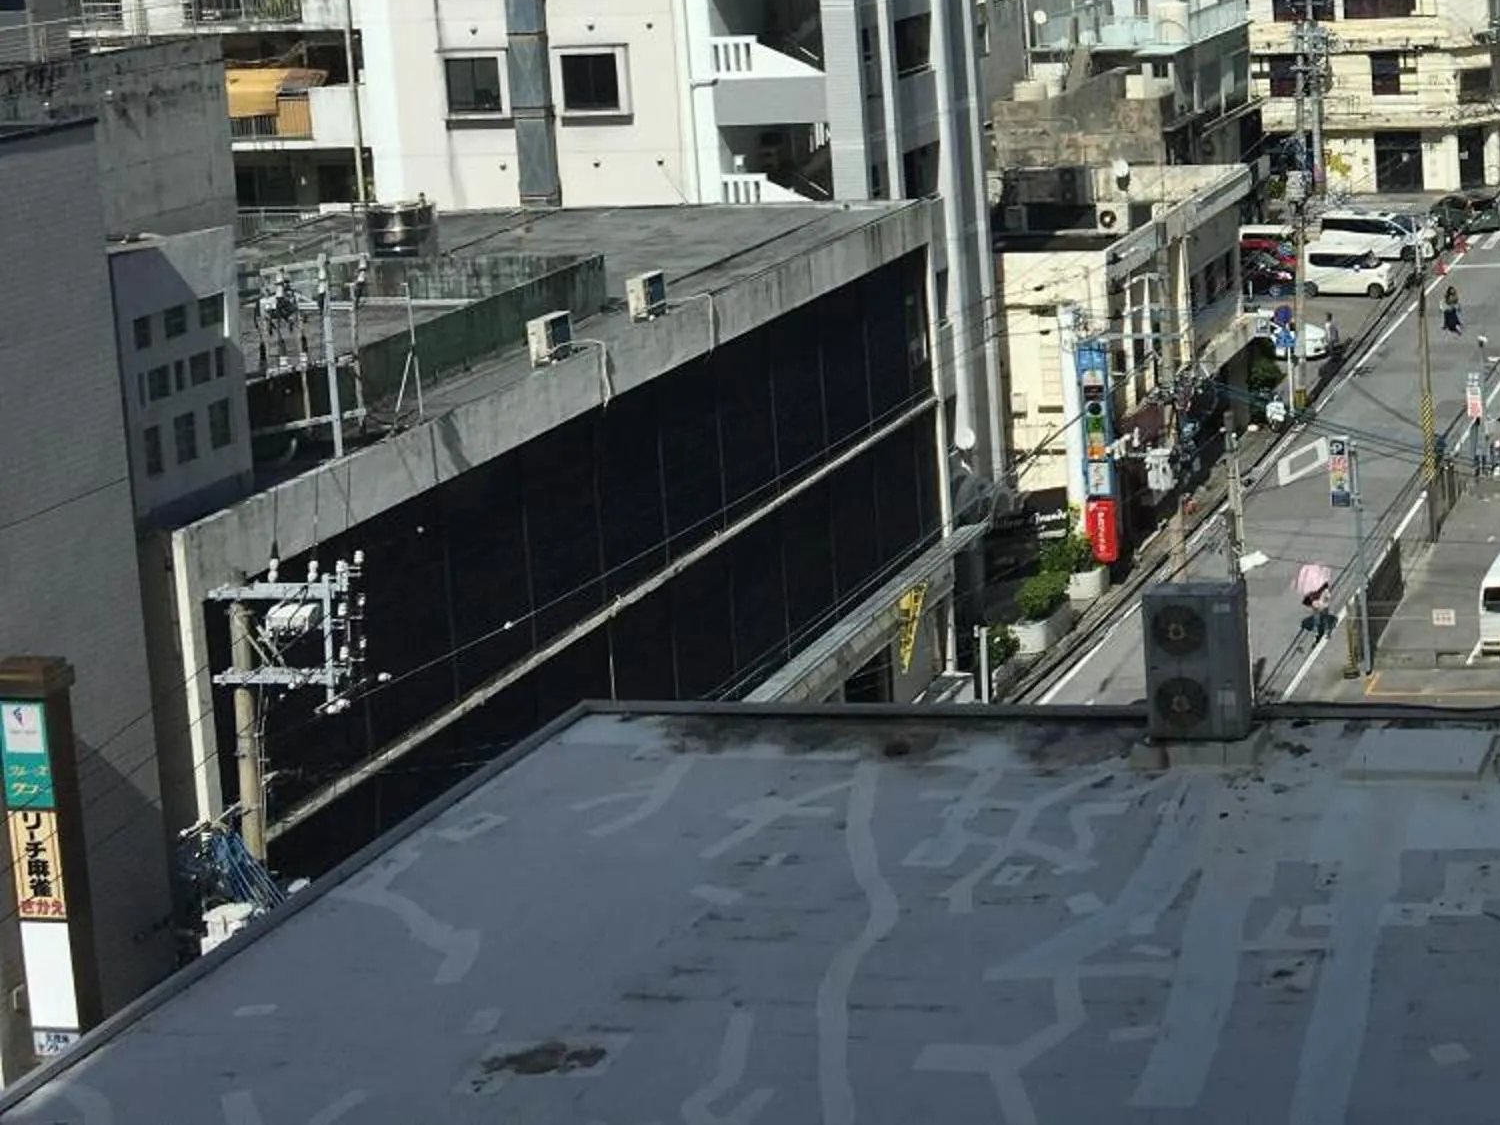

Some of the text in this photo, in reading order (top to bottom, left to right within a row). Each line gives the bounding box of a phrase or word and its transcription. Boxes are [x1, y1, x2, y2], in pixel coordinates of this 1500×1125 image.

[23, 812, 53, 897] リーチ麻雀
